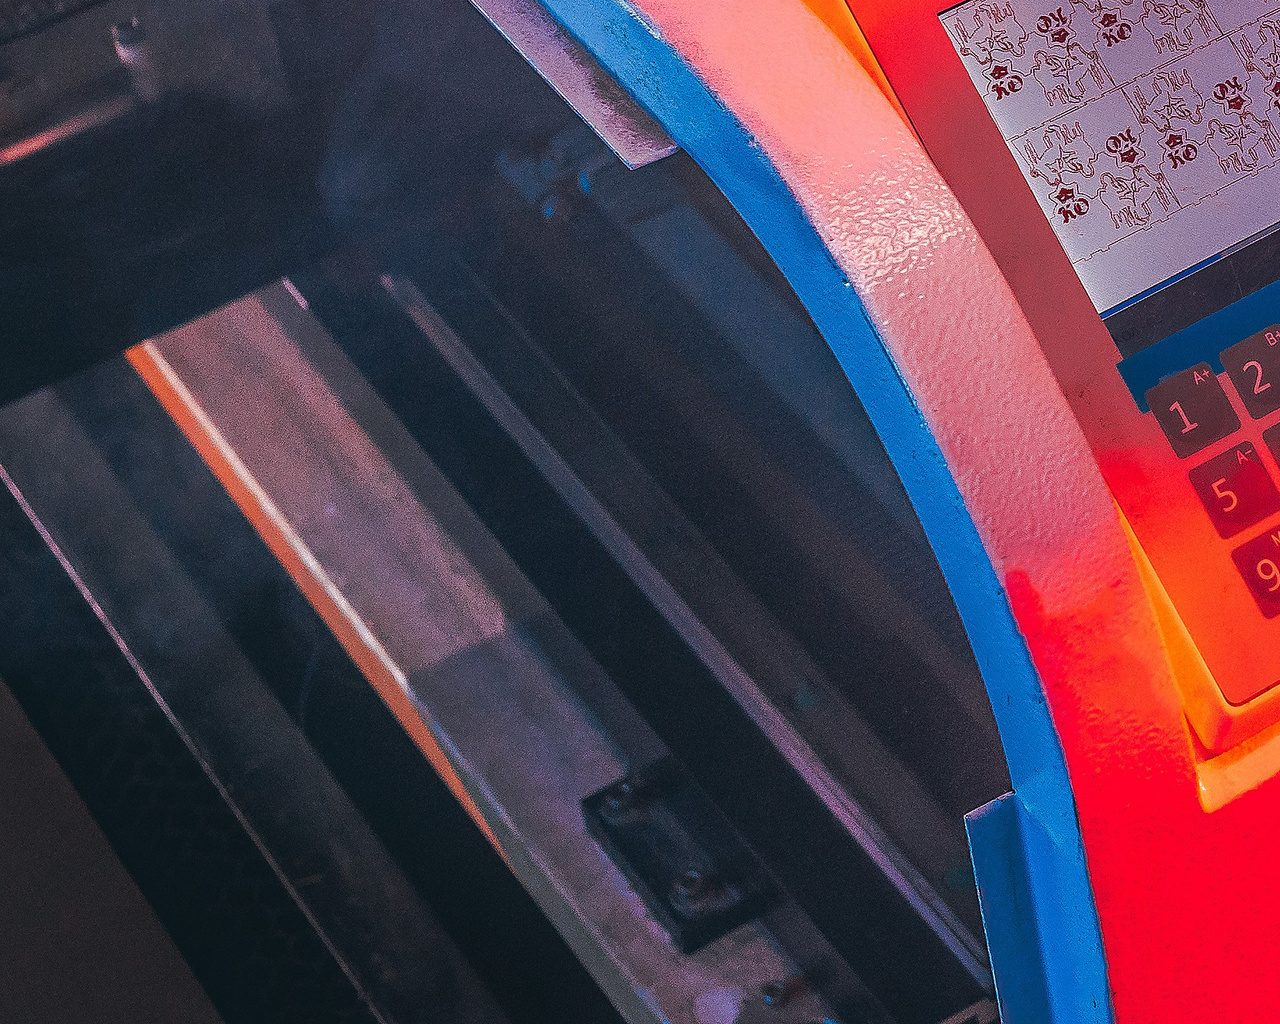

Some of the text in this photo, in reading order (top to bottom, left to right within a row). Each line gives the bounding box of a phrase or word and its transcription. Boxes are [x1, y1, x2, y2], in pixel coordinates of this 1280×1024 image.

[1192, 368, 1210, 385] A+
[1241, 359, 1271, 395] 2
[1168, 399, 1198, 434] 1
[1210, 477, 1238, 512] 5
